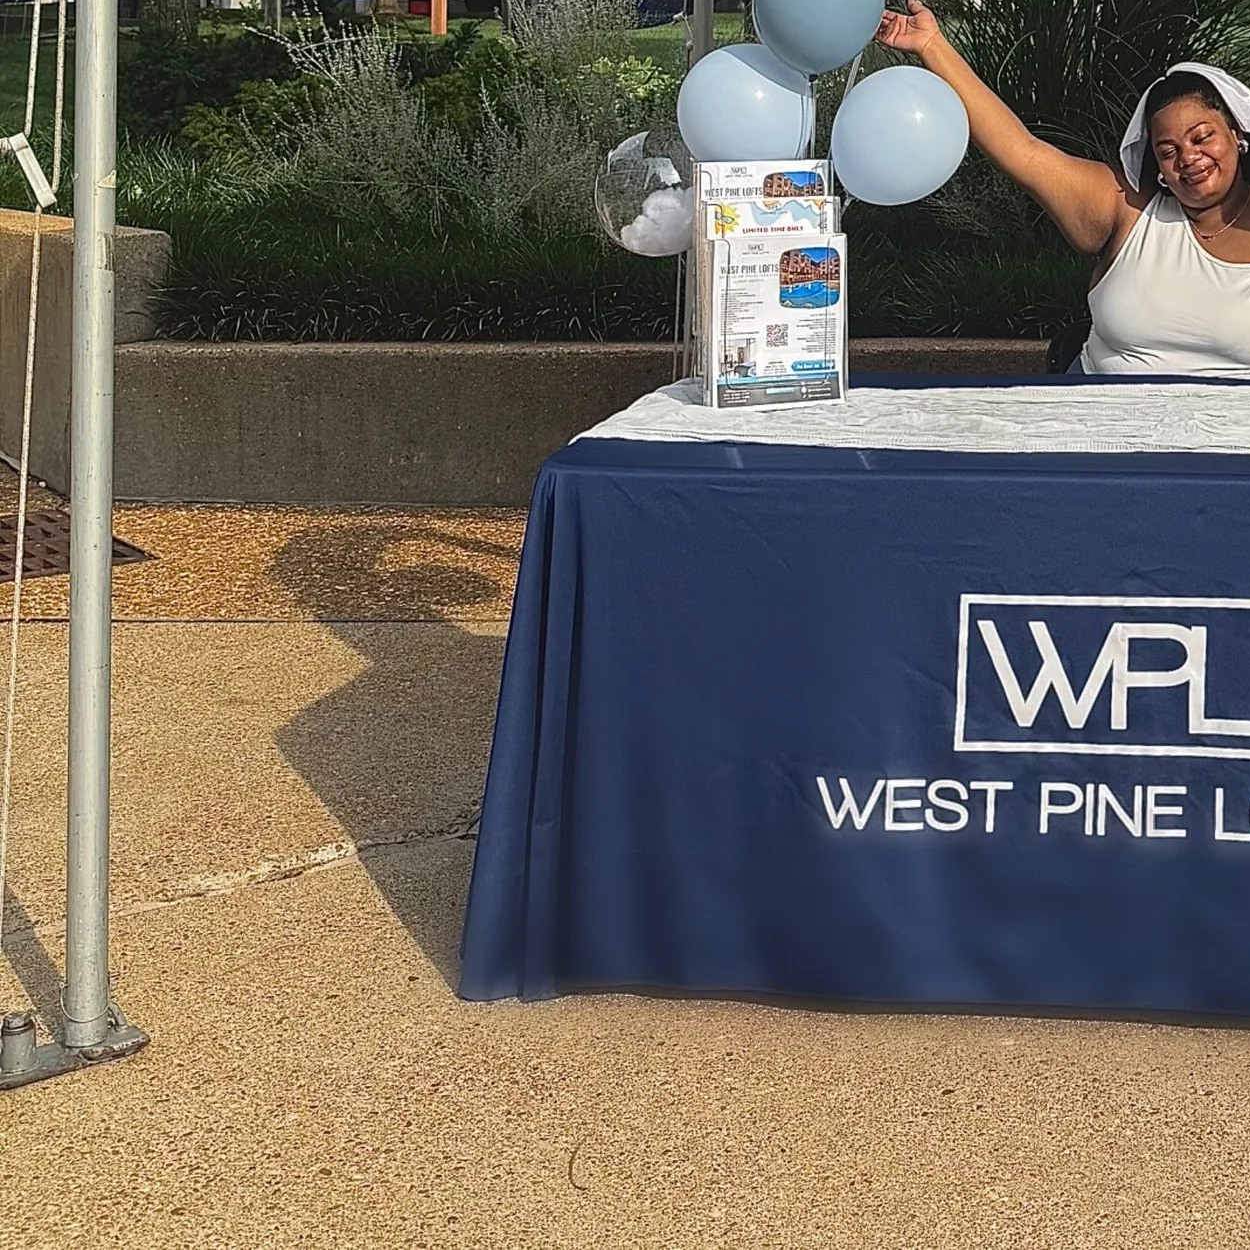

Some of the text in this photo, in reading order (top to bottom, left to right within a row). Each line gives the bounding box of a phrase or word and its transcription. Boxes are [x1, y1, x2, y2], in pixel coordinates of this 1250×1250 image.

[704, 187, 762, 197] WEST PINE LOFTS
[720, 263, 778, 274] WST PINE LOFTS
[816, 776, 1013, 833] WEST
[1039, 782, 1187, 838] PINE
